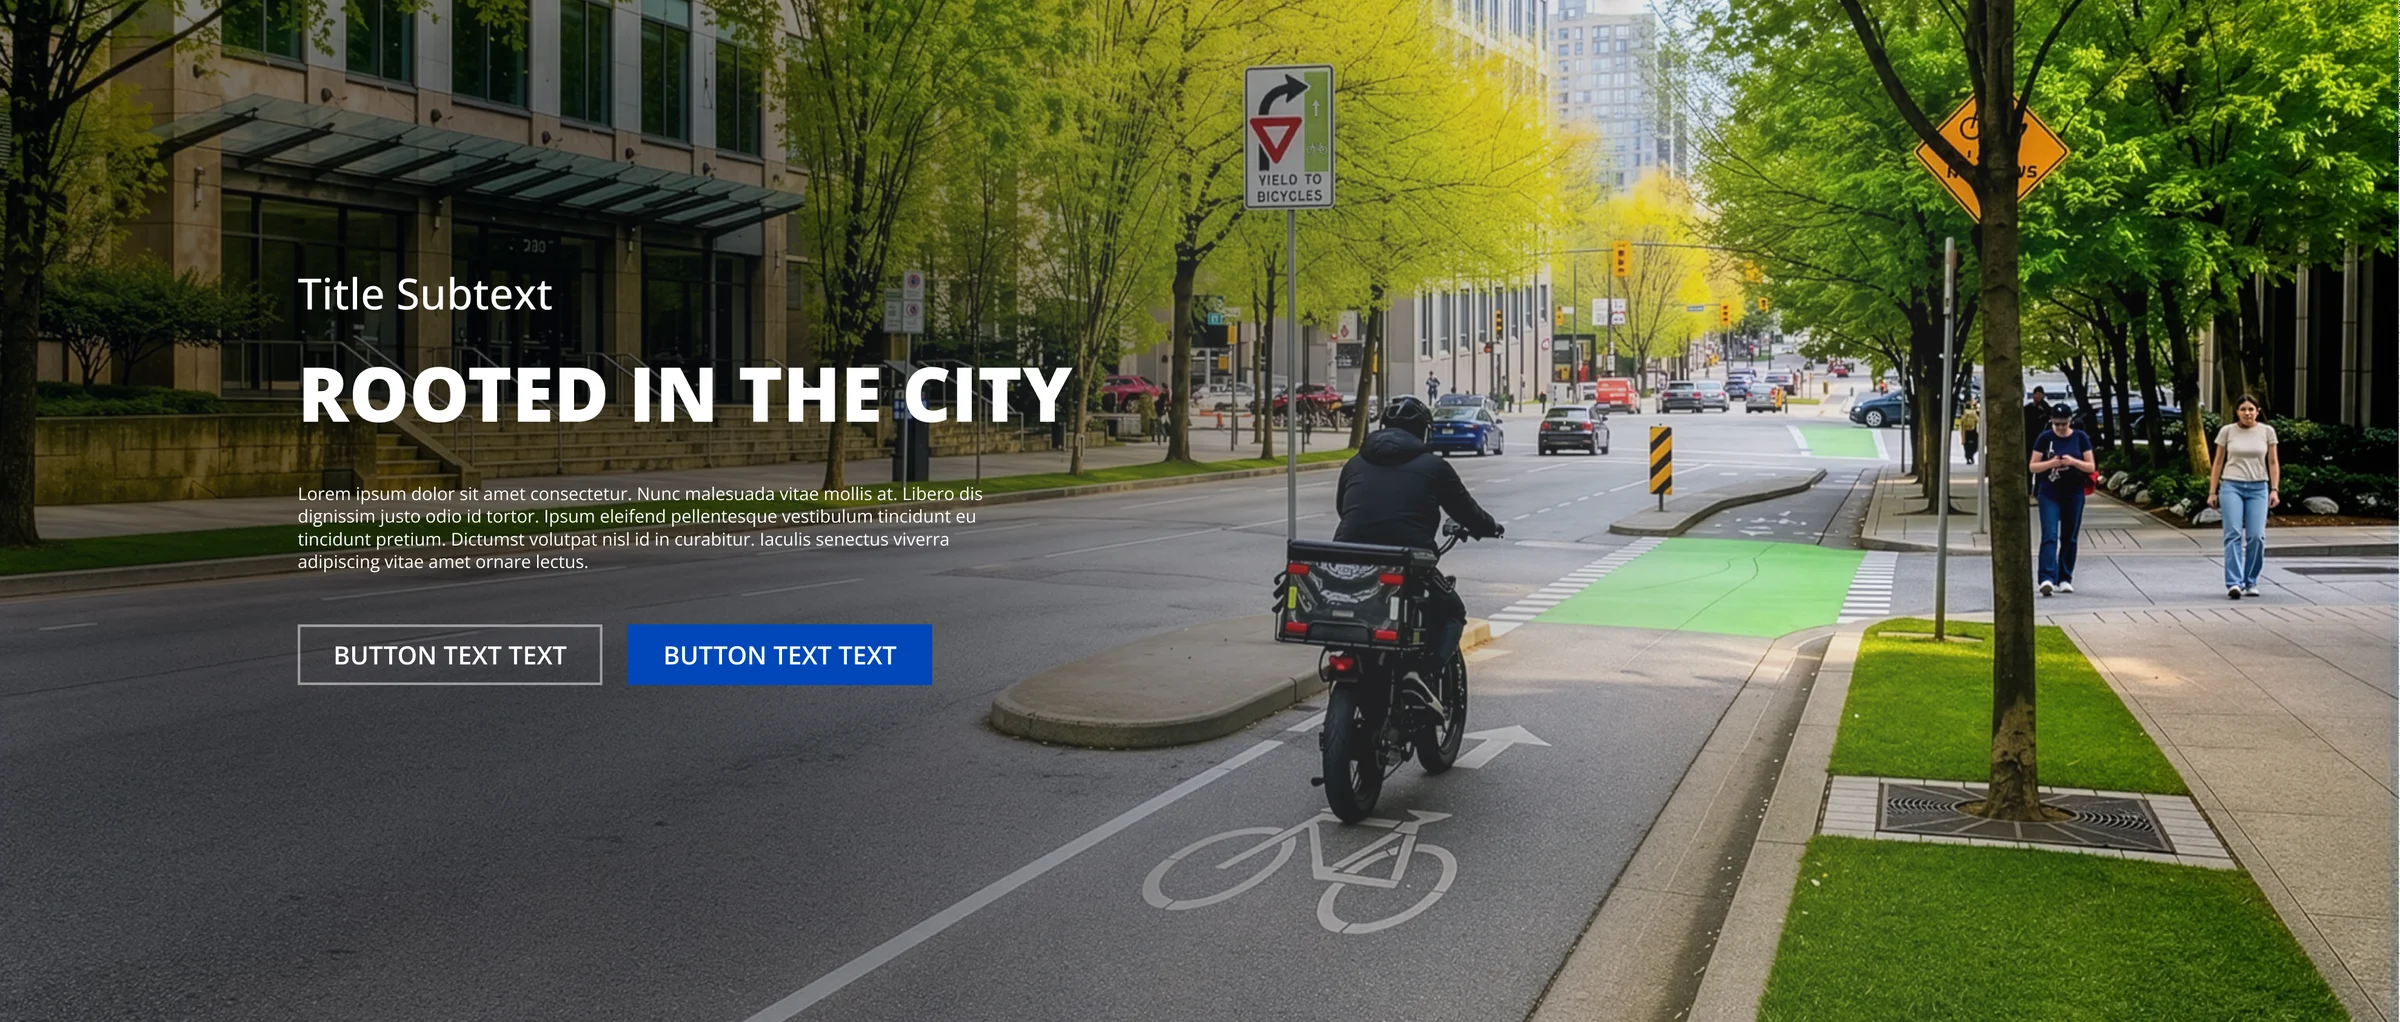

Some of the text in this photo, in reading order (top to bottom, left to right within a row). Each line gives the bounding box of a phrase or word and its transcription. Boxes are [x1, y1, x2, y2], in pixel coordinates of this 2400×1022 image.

[1259, 174, 1322, 186] YIELD TO
[1257, 190, 1323, 203] BICYCLES
